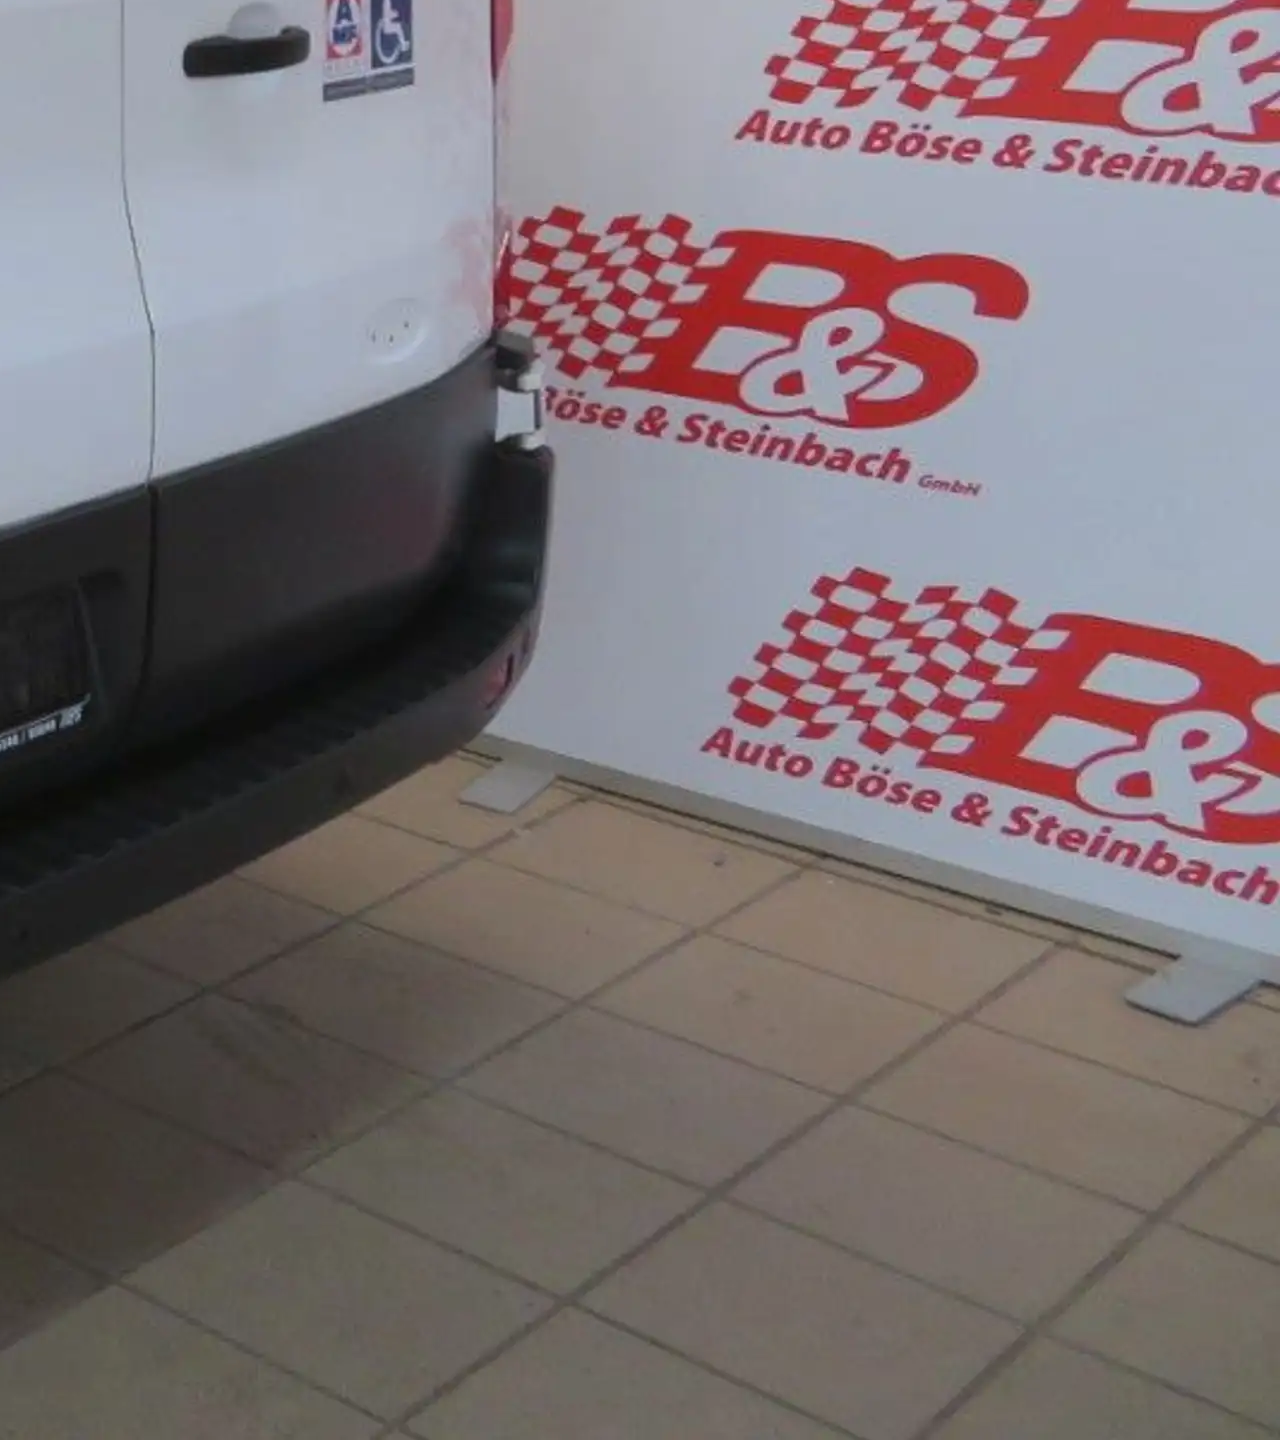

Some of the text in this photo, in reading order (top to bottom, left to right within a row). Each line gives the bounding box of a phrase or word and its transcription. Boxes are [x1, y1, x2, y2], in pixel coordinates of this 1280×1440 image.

[736, 110, 851, 149] Auto
[860, 120, 983, 164] Böse
[992, 134, 1036, 169] &
[611, 229, 1030, 430] B&S
[635, 405, 669, 438] &
[677, 413, 911, 483] Steinbach
[917, 473, 982, 497] GmbH
[700, 727, 1280, 904] Auto Böse & Steinbach
